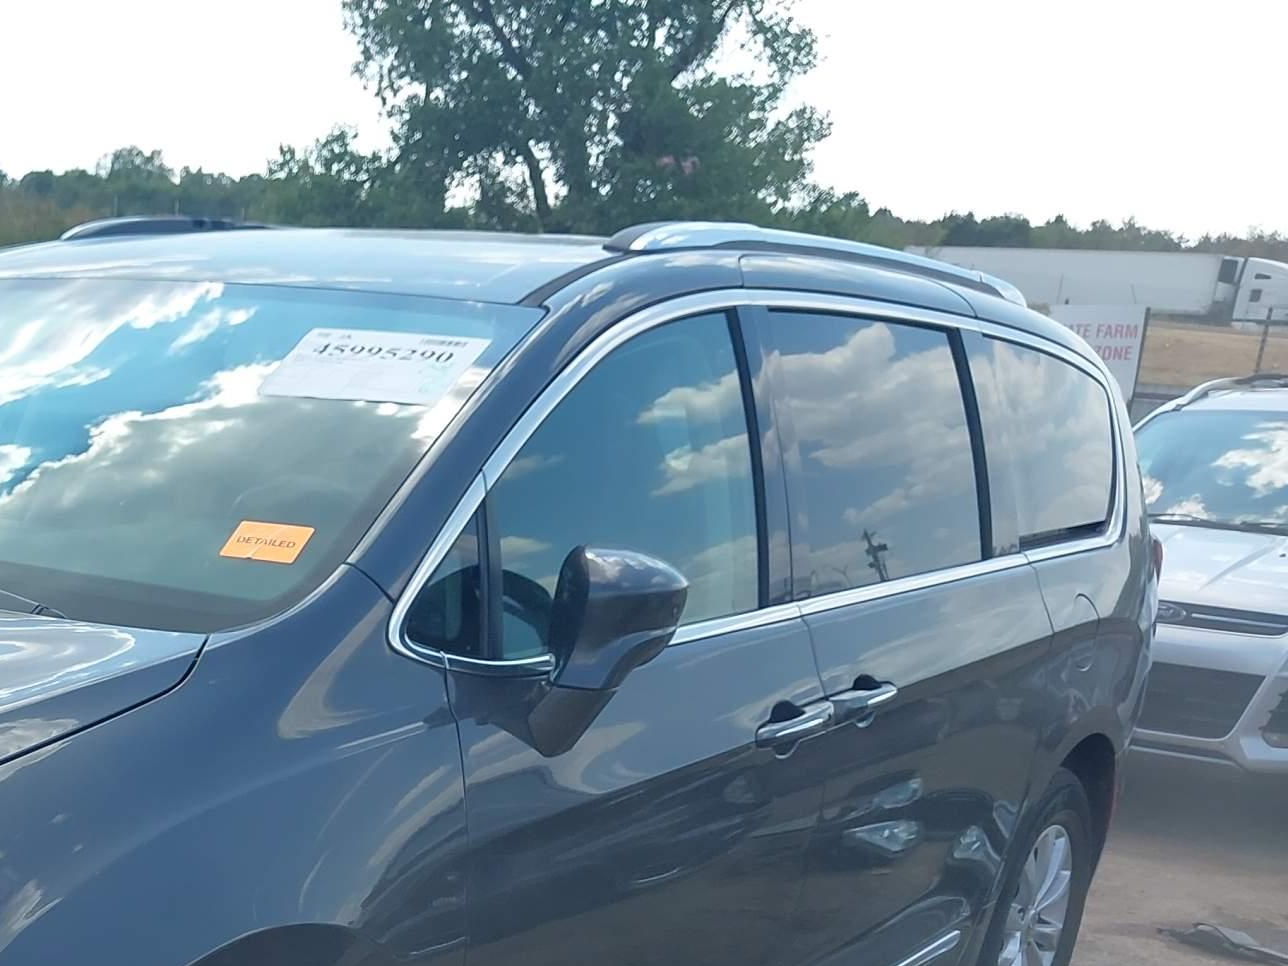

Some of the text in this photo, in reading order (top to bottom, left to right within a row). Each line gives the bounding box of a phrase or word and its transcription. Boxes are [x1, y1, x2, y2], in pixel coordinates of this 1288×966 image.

[1095, 323, 1138, 339] FARM
[313, 342, 454, 363] 45995290
[236, 535, 296, 549] DETAILED
